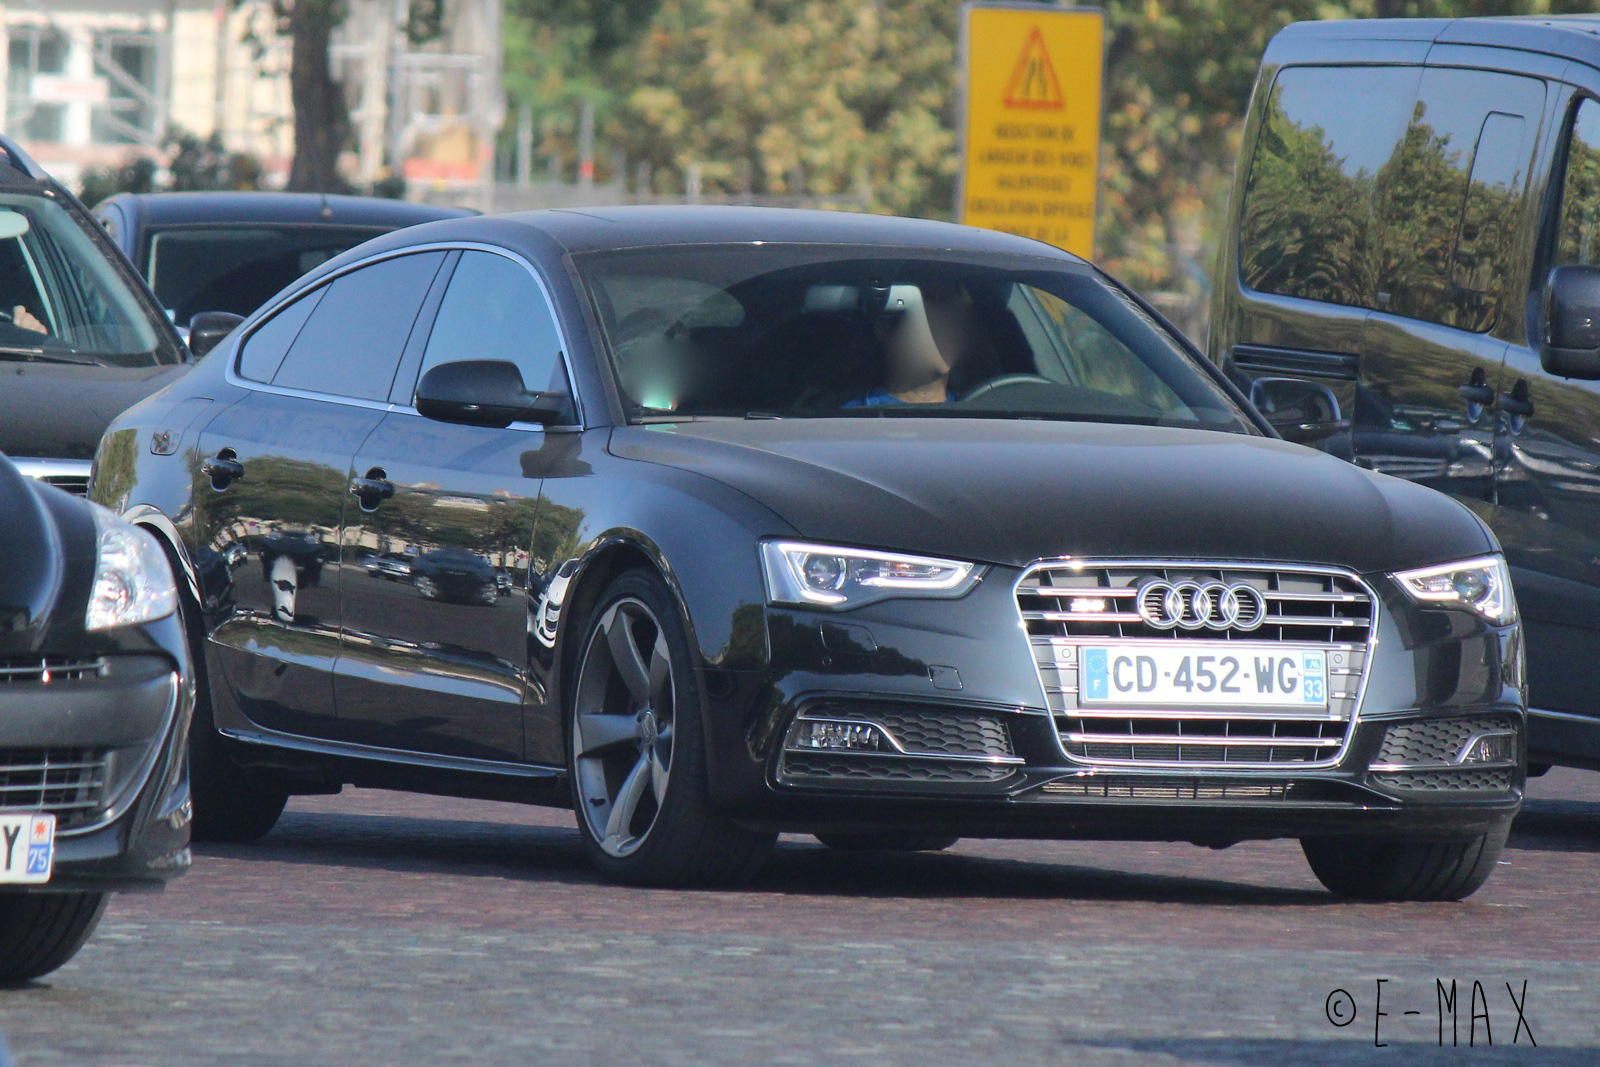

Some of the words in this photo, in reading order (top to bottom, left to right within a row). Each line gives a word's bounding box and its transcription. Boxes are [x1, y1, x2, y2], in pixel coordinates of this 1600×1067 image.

[1093, 679, 1101, 691] F
[1112, 655, 1298, 694] CD-452-WG
[1304, 679, 1323, 699] 33
[28, 847, 48, 872] 75
